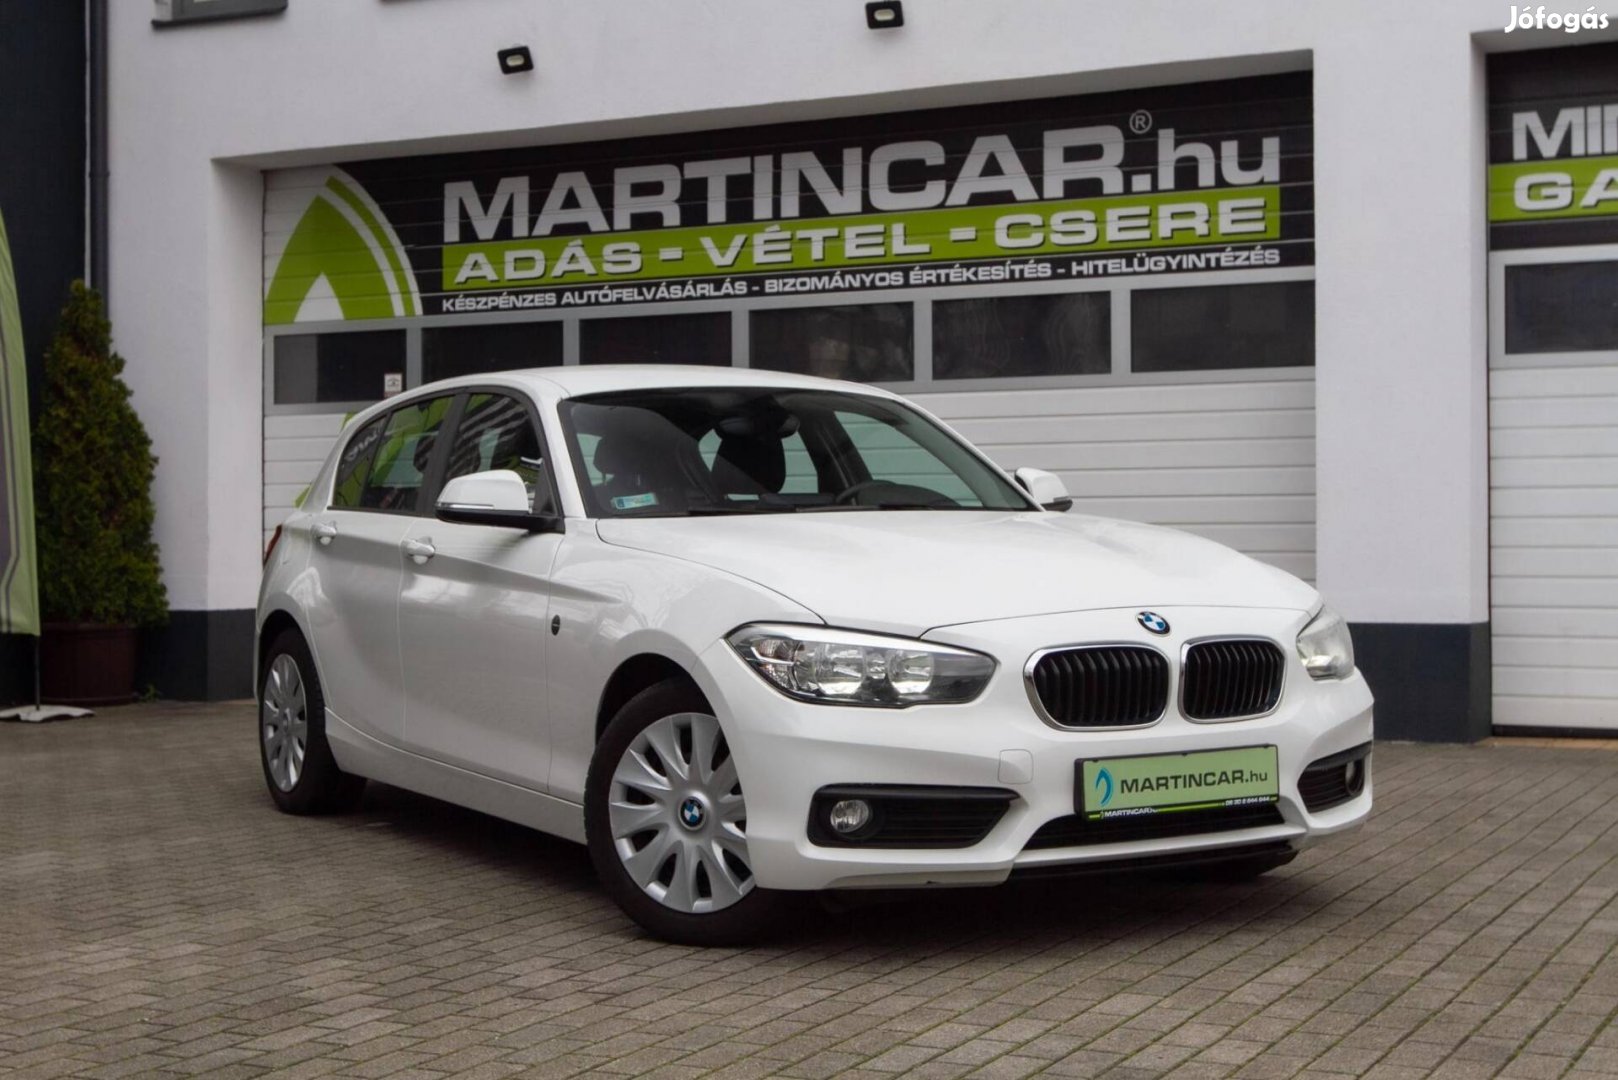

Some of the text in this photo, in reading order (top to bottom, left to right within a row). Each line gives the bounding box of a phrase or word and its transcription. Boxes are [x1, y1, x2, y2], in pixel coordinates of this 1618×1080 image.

[454, 239, 643, 284] ADÁS
[700, 223, 932, 267] VÉTEL
[995, 198, 1267, 249] CSERE
[442, 291, 557, 312] KÉSZPÉNZES
[561, 278, 748, 305] AUTÓFELVÁSÁRLÁS
[764, 271, 904, 294] BIZOMÁNYOS
[909, 260, 1052, 285] ÉRTÉKESÍTÉS
[1071, 245, 1281, 276] HITELÜGYINTÉZÉS
[1120, 769, 1268, 794] MARTINCAR.hu
